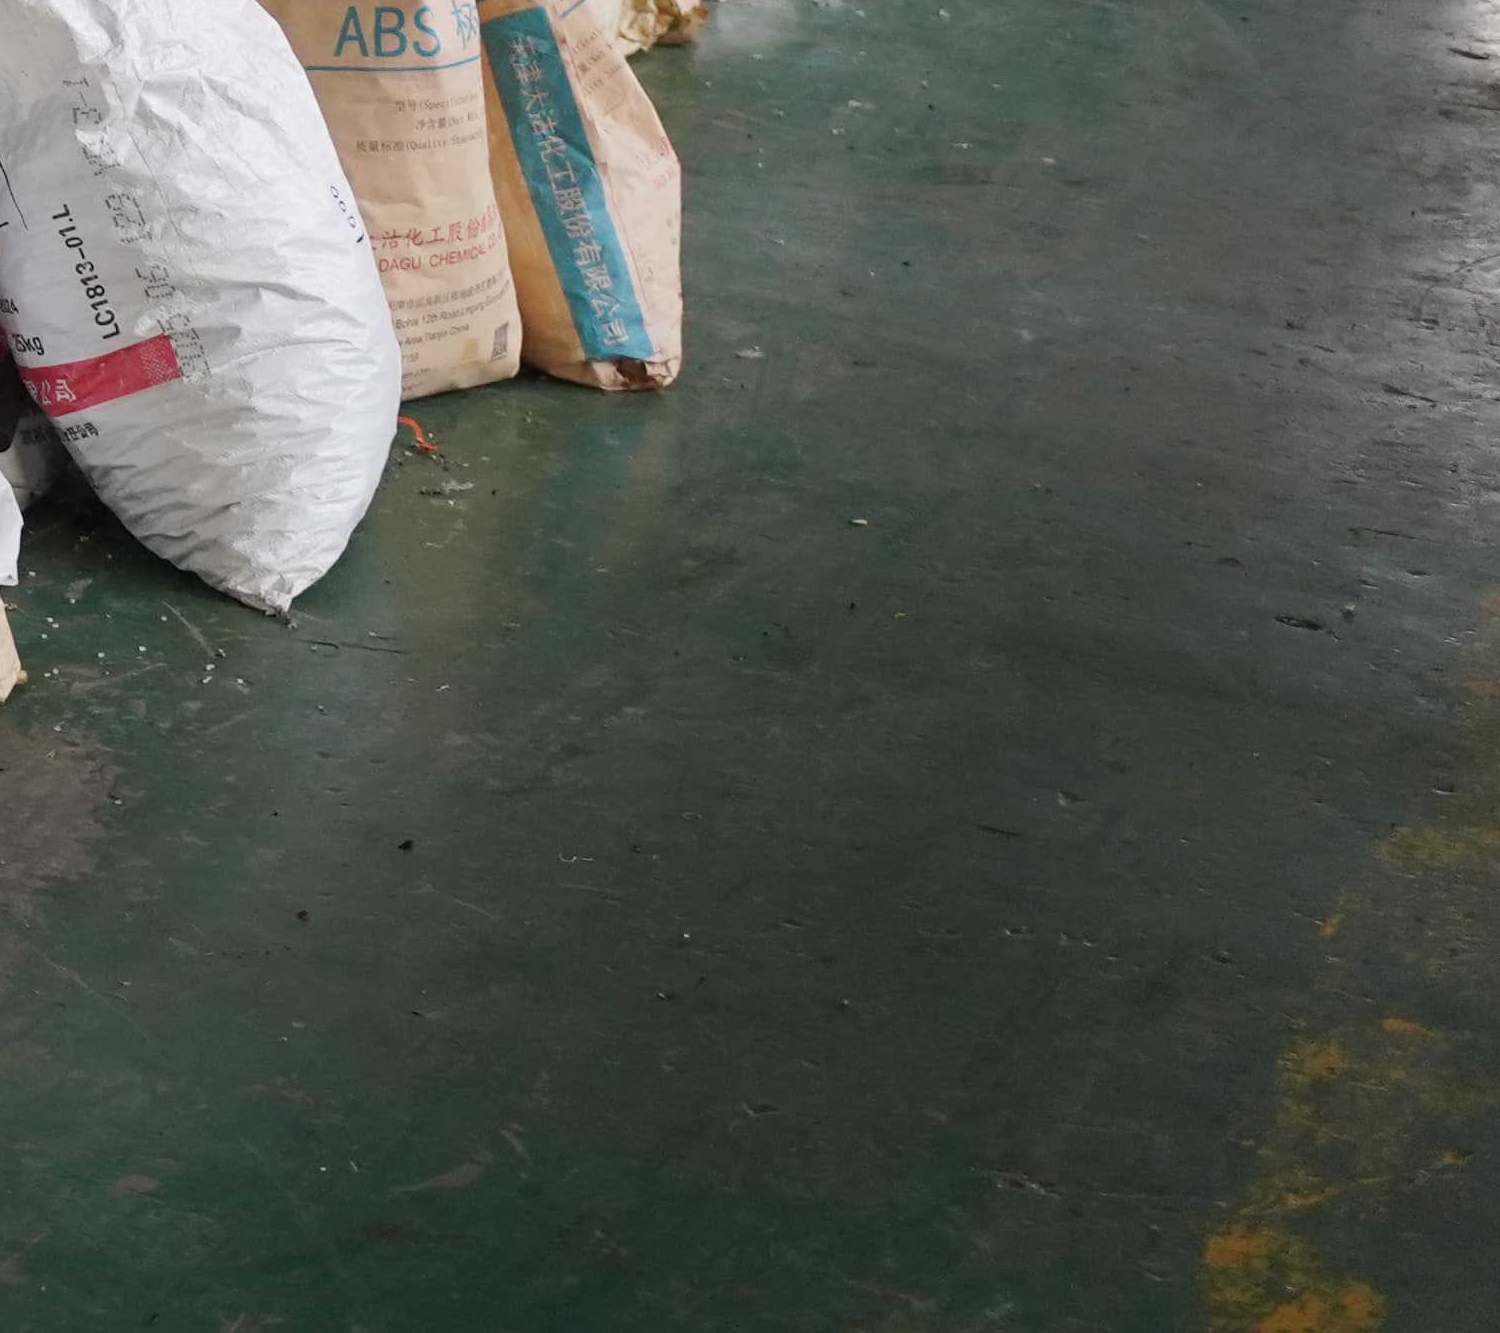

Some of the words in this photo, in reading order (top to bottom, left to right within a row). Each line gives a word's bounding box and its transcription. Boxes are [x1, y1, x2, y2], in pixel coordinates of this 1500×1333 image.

[333, 6, 441, 58] ABS
[51, 203, 122, 340] LC1813-01.L
[379, 256, 422, 273] DAGU
